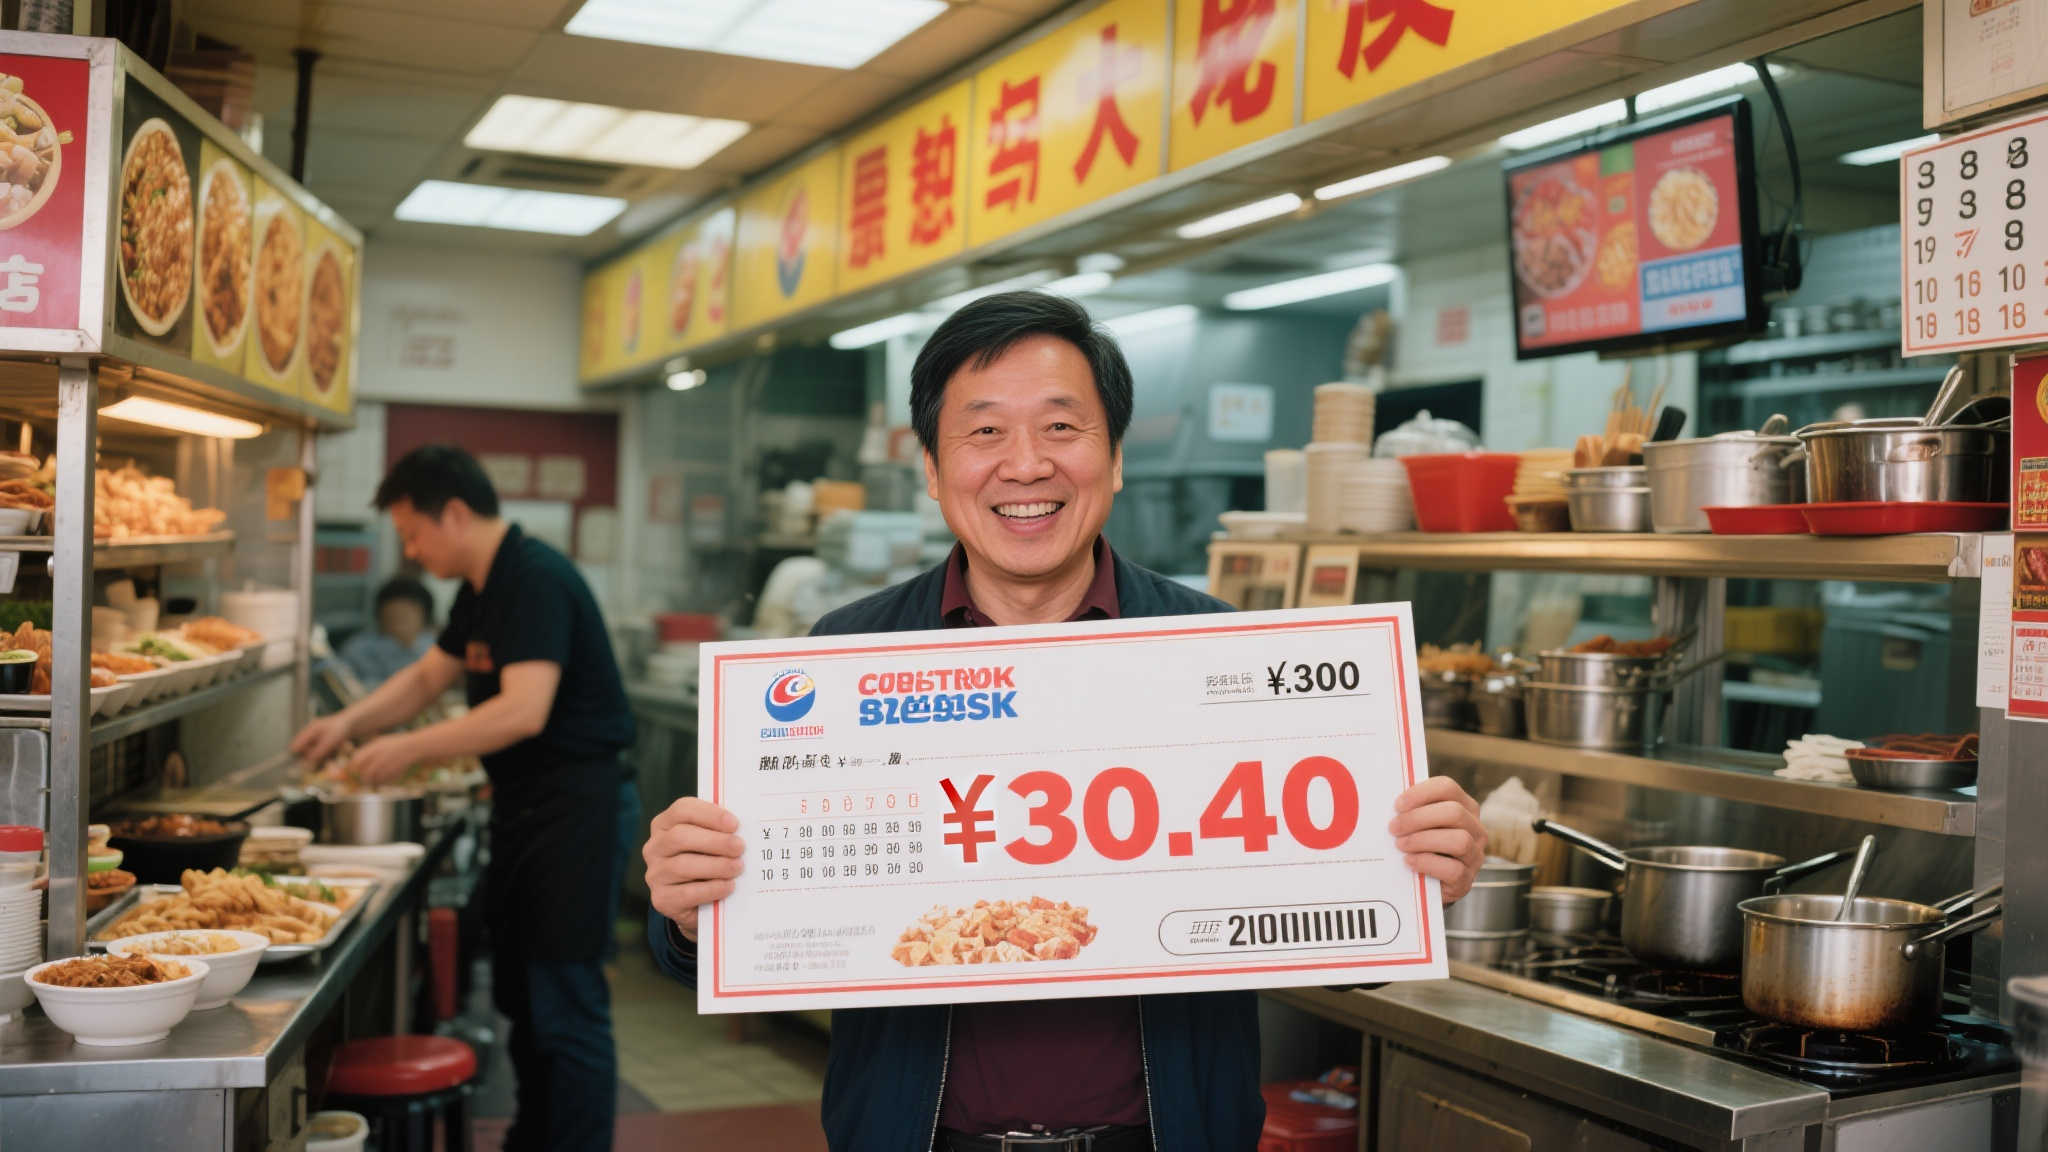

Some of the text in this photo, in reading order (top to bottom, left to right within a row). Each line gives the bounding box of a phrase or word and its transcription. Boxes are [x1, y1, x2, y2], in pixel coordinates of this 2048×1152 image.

[1960, 150, 1978, 180] 8
[1917, 197, 1934, 227] 9
[2005, 179, 2026, 210] 8
[1913, 236, 1936, 264] 19
[1914, 277, 1938, 305] 10
[1998, 263, 2026, 293] 10
[1267, 661, 1360, 695] ¥.300
[939, 756, 1359, 865] ¥30.40
